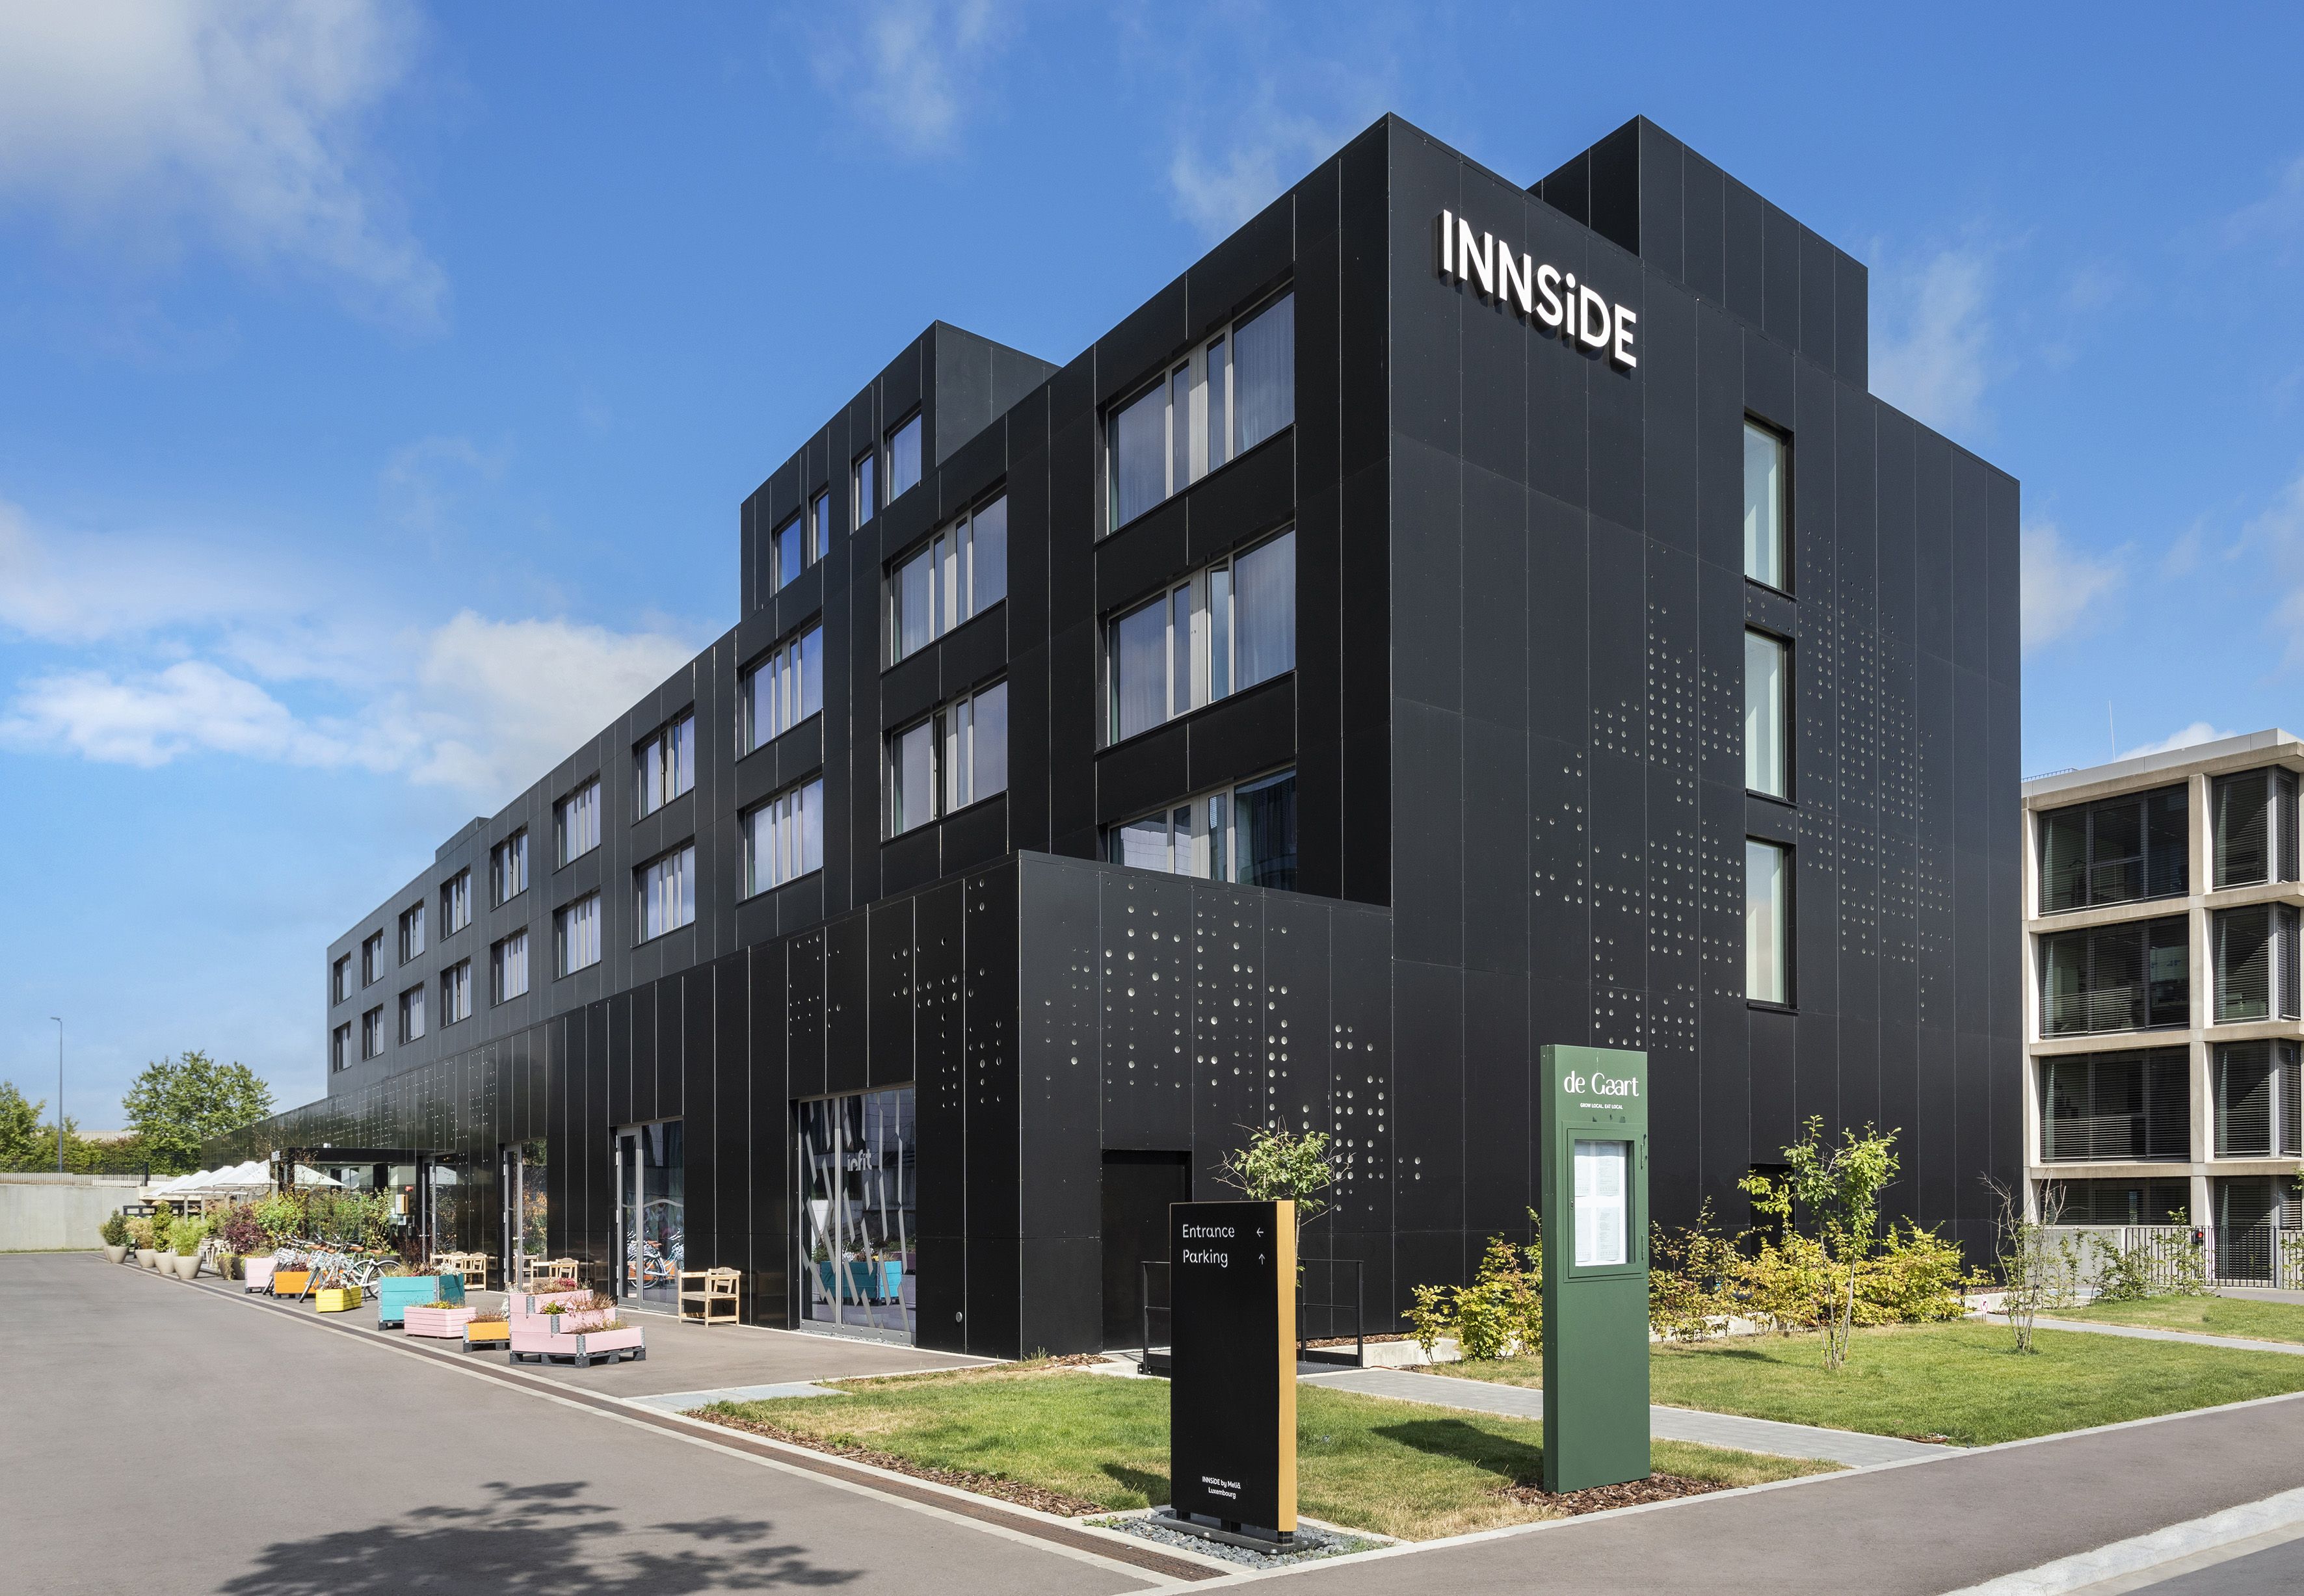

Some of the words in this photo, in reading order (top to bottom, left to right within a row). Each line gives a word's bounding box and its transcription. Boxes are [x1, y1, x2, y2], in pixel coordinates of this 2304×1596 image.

[1563, 1070, 1585, 1094] de
[1591, 1072, 1639, 1097] Gaart
[847, 1148, 872, 1171] infit
[1182, 1223, 1236, 1238] Entrance
[1183, 1249, 1228, 1268] Parking
[1221, 1480, 1227, 1488] by
[1208, 1486, 1236, 1500] Luxembourg
